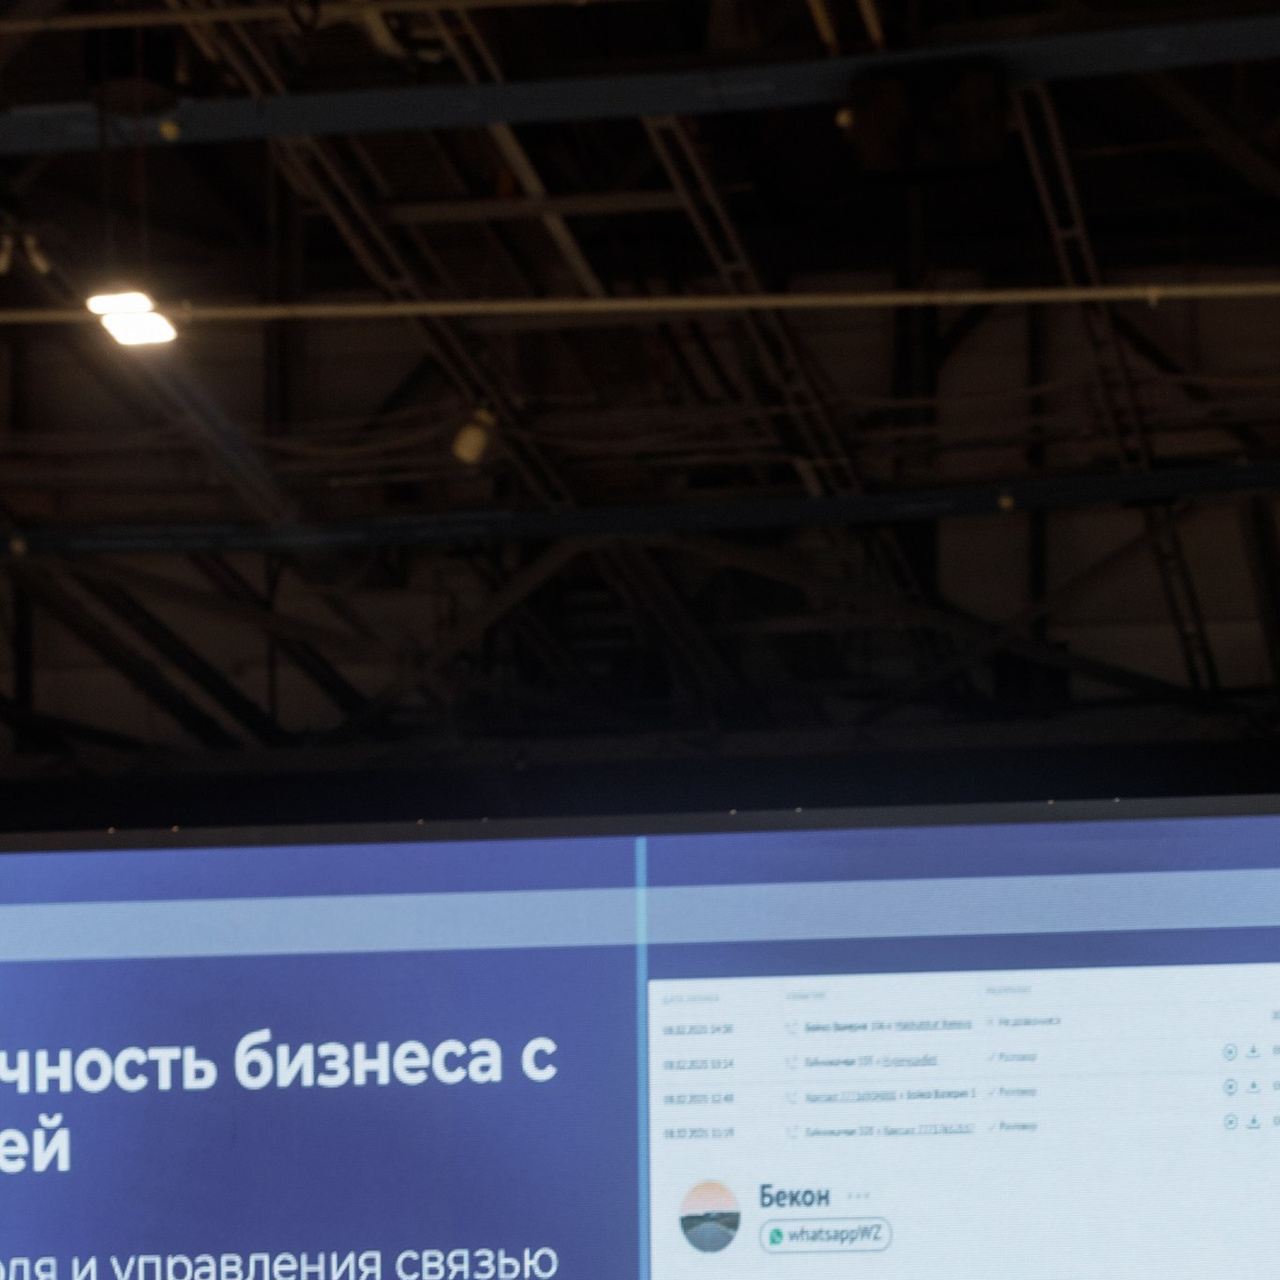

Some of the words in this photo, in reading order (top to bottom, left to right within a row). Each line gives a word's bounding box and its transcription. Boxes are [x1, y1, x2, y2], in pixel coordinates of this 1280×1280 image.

[0, 1046, 218, 1094] чность
[234, 1028, 503, 1090] бизнеса
[521, 1036, 557, 1082] с
[0, 1113, 70, 1174] ей
[759, 1183, 830, 1209] Бекон
